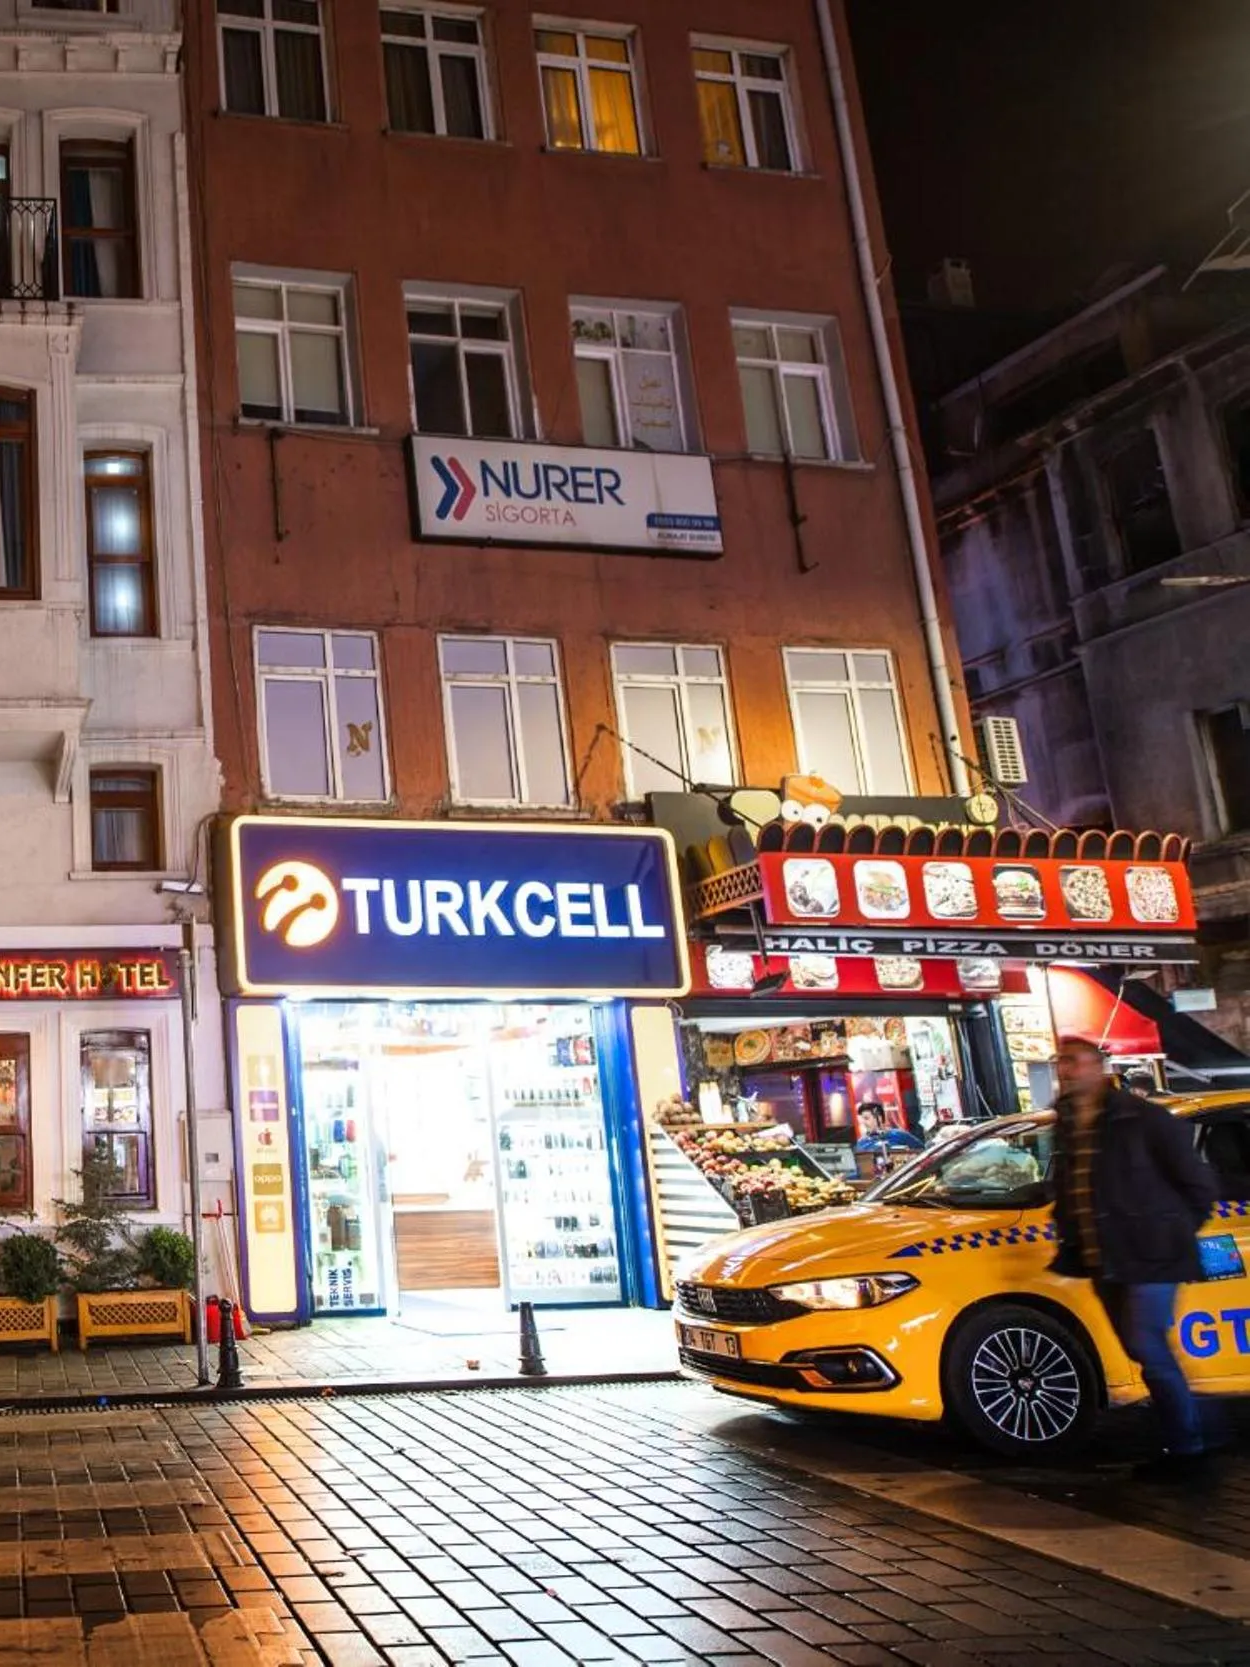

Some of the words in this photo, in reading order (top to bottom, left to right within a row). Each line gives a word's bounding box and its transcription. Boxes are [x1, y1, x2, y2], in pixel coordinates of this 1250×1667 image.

[480, 460, 626, 505] NURER
[341, 878, 666, 938] TURKCELL
[1035, 941, 1157, 958] DÖNER
[76, 960, 174, 992] HOTEL
